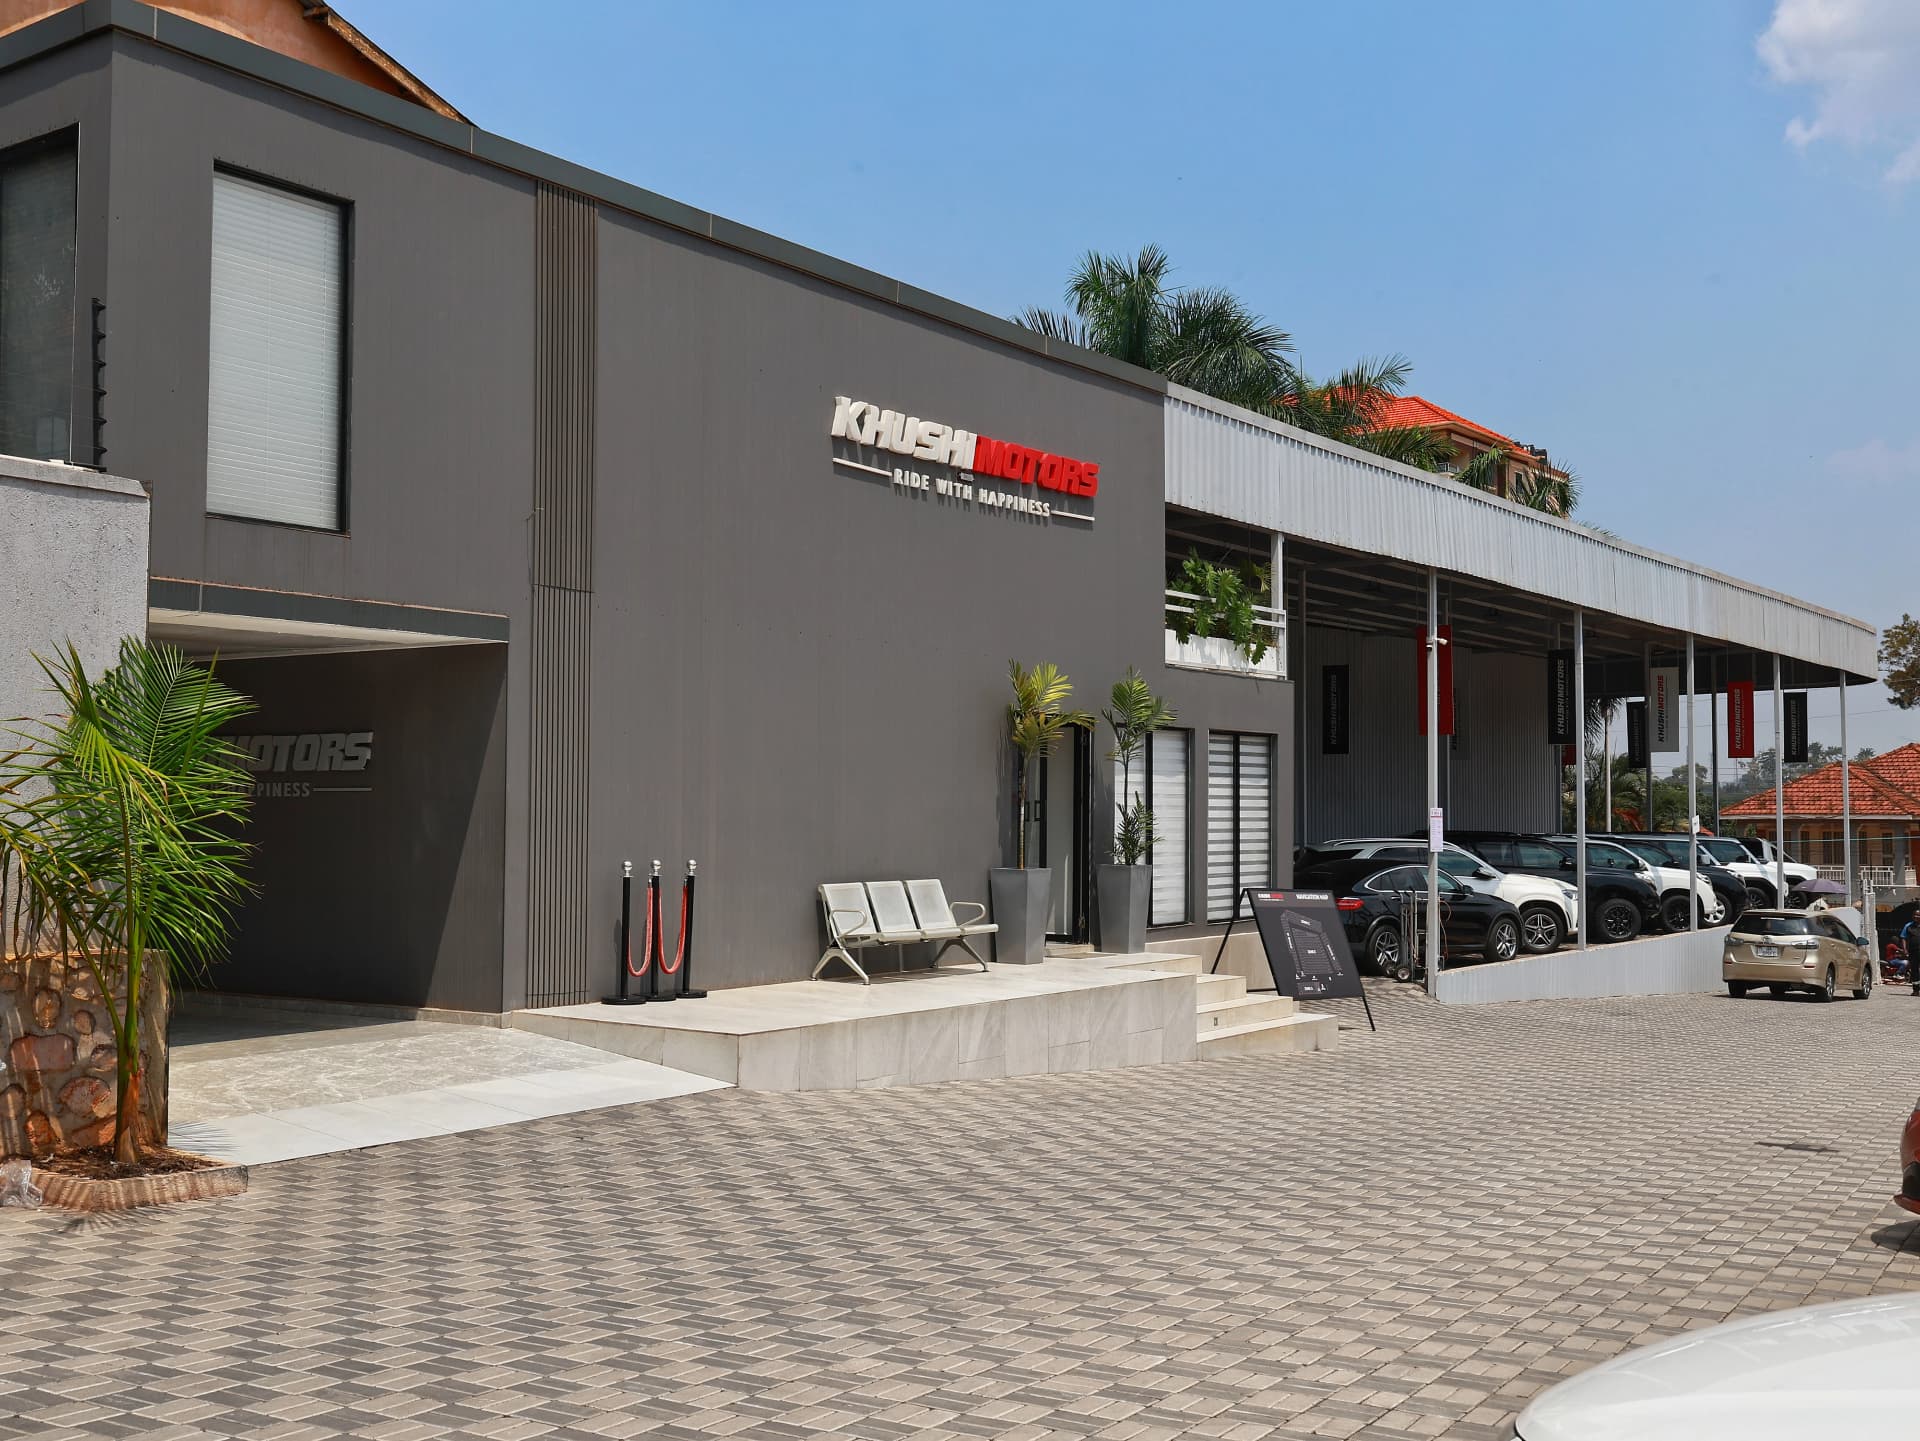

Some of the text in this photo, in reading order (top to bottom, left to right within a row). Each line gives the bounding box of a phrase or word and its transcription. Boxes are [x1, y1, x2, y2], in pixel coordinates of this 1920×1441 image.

[892, 468, 1051, 517] RIDE WITH HAPPINESS
